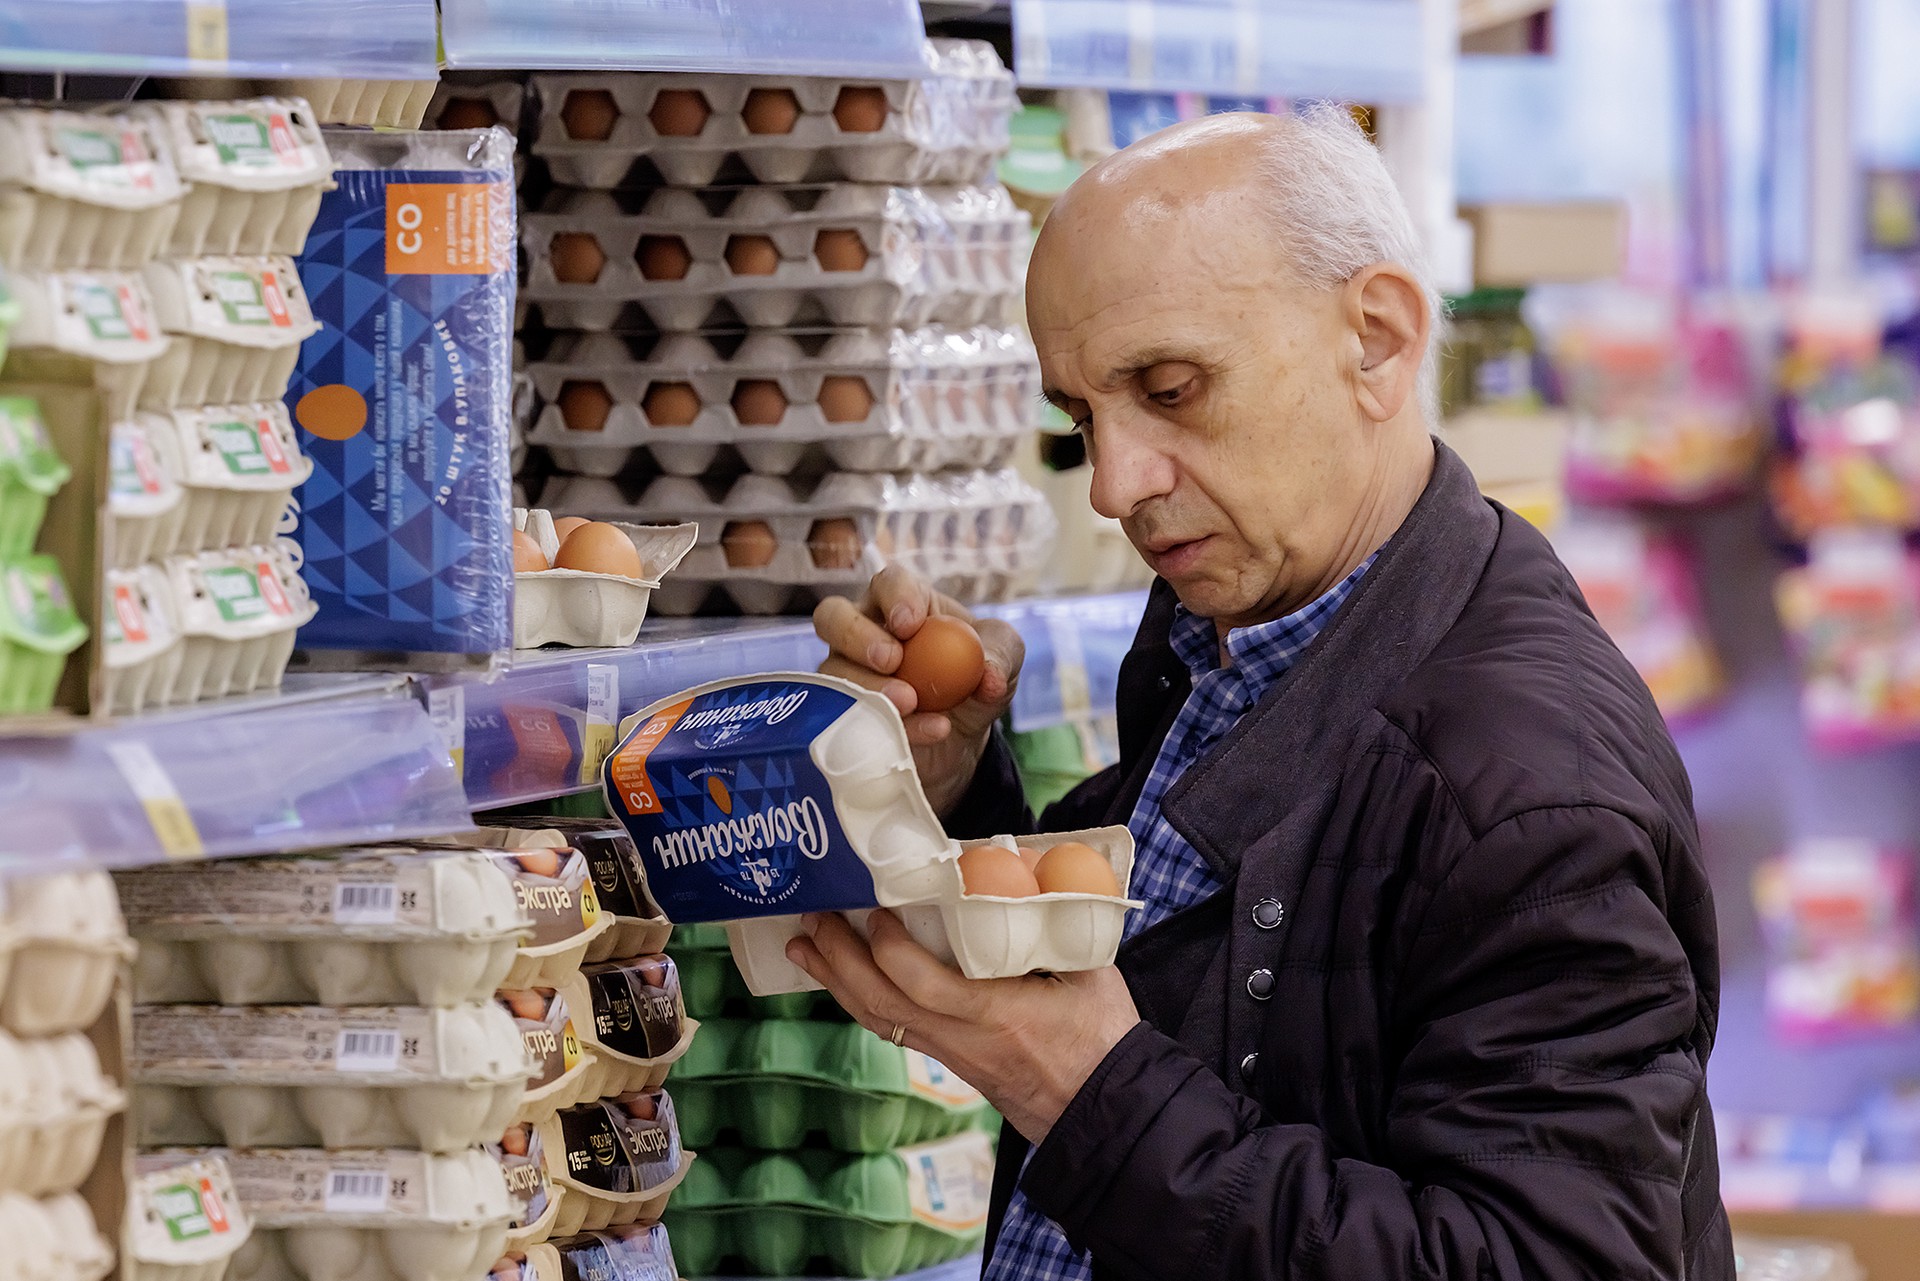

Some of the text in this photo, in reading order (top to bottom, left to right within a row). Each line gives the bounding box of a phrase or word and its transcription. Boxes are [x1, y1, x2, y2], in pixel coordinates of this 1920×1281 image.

[396, 203, 423, 254] СО
[434, 318, 468, 506] 20 ШТУК В УПАКОВКЕ
[674, 690, 808, 732] Волжанин
[643, 721, 668, 736] СО
[629, 790, 653, 808] СО
[652, 795, 828, 870] Волжанин
[739, 868, 781, 881] 19 78
[512, 880, 573, 917] Экстра
[723, 885, 764, 905] ПРИРОДЫ
[767, 896, 777, 905] ОТ
[596, 1014, 608, 1036] 15
[640, 992, 675, 1026] Экстра
[521, 1029, 558, 1061] кстра
[625, 1126, 669, 1158] Экстра
[568, 1150, 583, 1172] 15
[500, 1163, 540, 1195] Экстра
